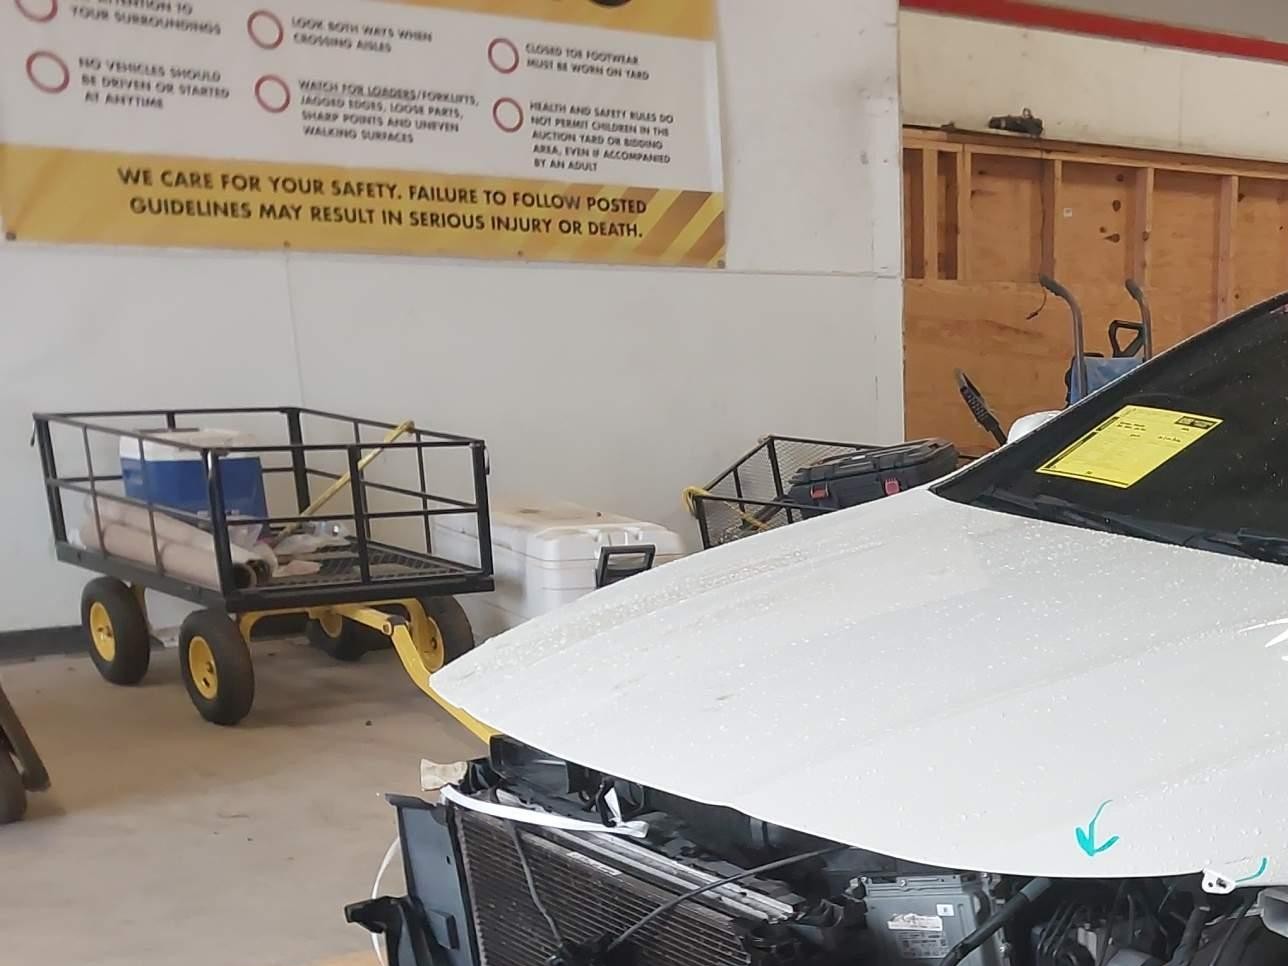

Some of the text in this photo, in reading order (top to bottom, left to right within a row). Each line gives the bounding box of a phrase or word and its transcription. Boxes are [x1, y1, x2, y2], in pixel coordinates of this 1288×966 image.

[177, 2, 193, 15] TO
[72, 6, 221, 36] YOUR SURROUNDINGS
[291, 16, 433, 43] LOOK BOTH WAYS WHEN
[293, 32, 392, 53] CROSSING AISLES
[525, 43, 639, 66] CLOSED TOE FOOTWEAR
[79, 56, 222, 83] NO VEHICLES SHOULD
[527, 58, 650, 81] MUST BE WORN ON YARD
[82, 74, 230, 99] BE DRIVEN OR STARTED
[299, 79, 339, 94] WATCH
[342, 83, 365, 97] FOR
[85, 91, 164, 109] AT ANYTIME
[300, 94, 345, 109] JAGGED
[390, 102, 425, 116] LOOSE
[301, 109, 460, 133] SHARP POINTS AND UNEVEN
[530, 101, 674, 125] HEALTH AND SAFETY RULES DO
[303, 124, 414, 144] WALKING SURFACES
[531, 115, 670, 138] NOT PERMIT CHILDREN IN THE
[532, 130, 664, 151] AUCTION YARD OR BIDDING
[534, 158, 598, 172] BY AN ADULT
[565, 146, 590, 159] EVEN
[593, 149, 600, 159] IF
[603, 150, 672, 165] ACCOMPANIED
[118, 166, 647, 215] WE CARE FOR YOUR SAFETY. FAILURE TO FOLLOW POSTED
[129, 195, 643, 239] GUIDELINES MAY RESULT IN SERIOUS INJURY OR DEATH.
